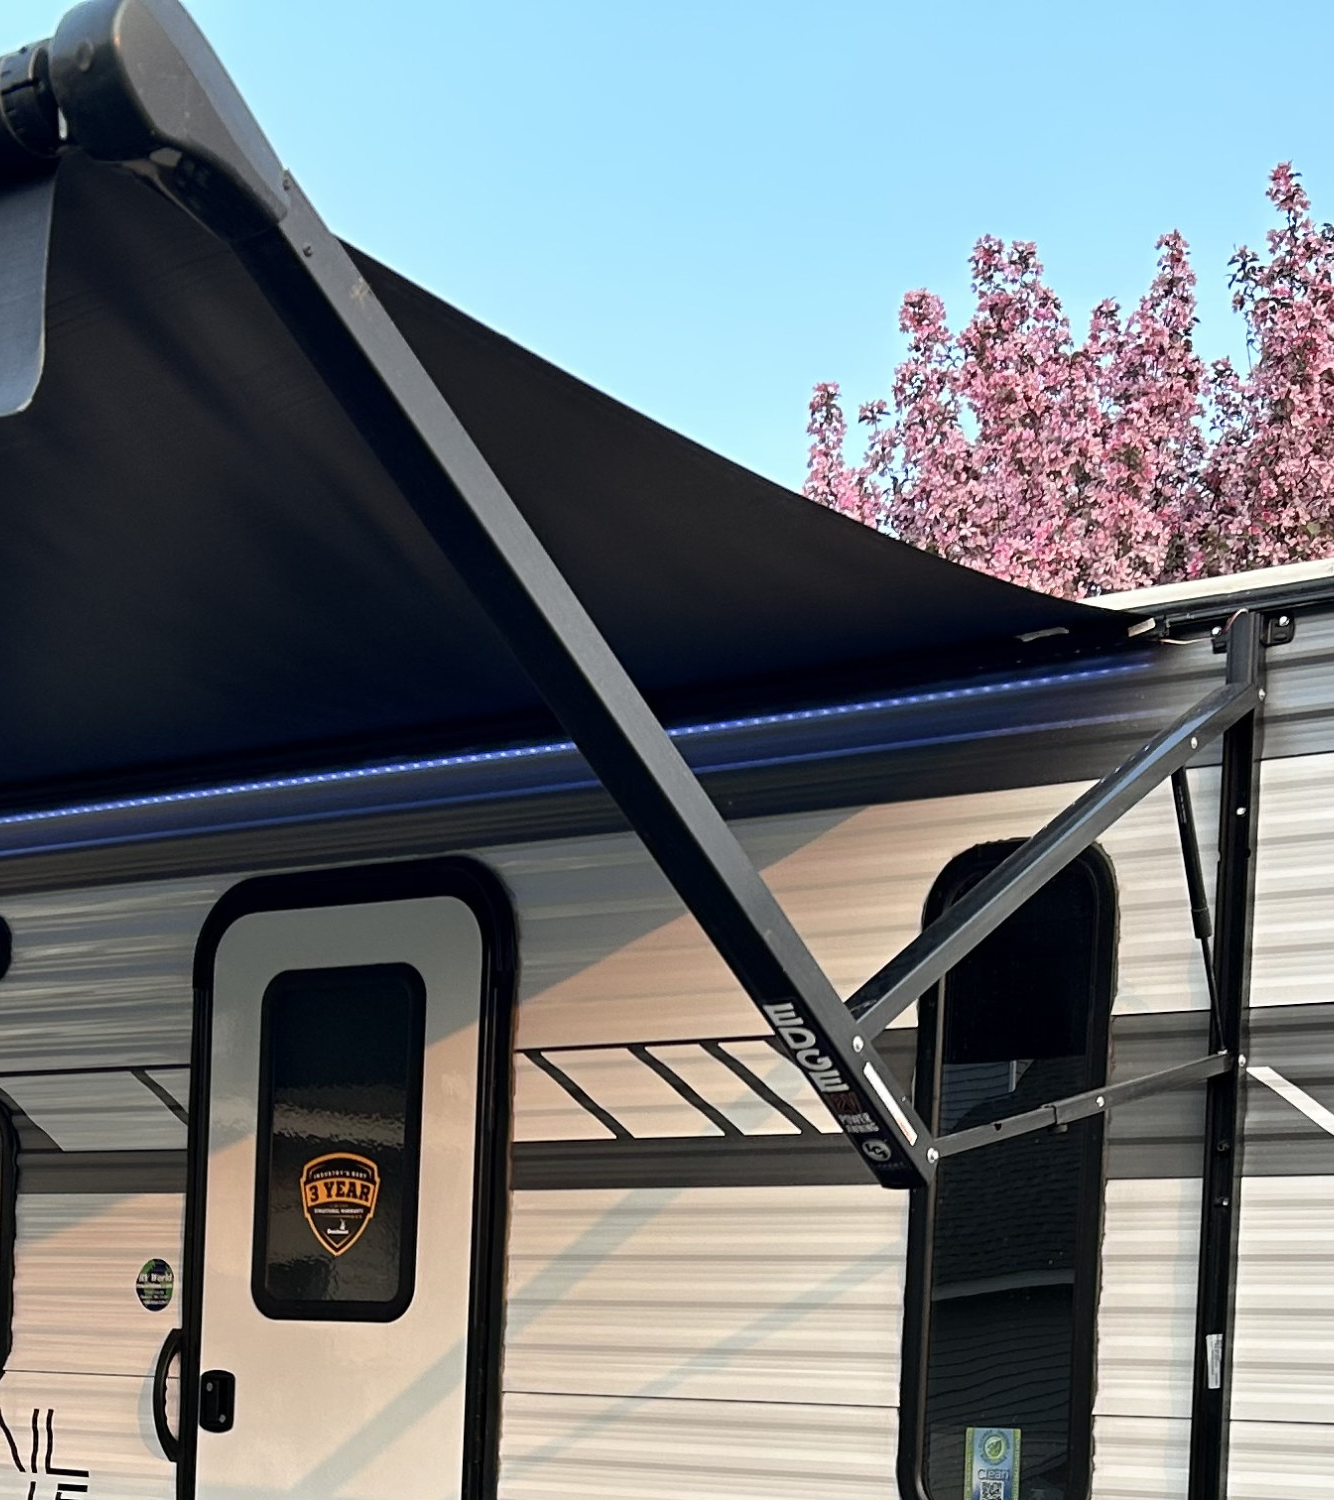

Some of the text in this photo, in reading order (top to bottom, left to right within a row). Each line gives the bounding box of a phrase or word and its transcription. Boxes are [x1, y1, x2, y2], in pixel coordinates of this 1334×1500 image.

[762, 1001, 850, 1093] EDGE
[309, 1180, 371, 1202] 3 YEAR
[977, 1469, 1009, 1481] Clean
